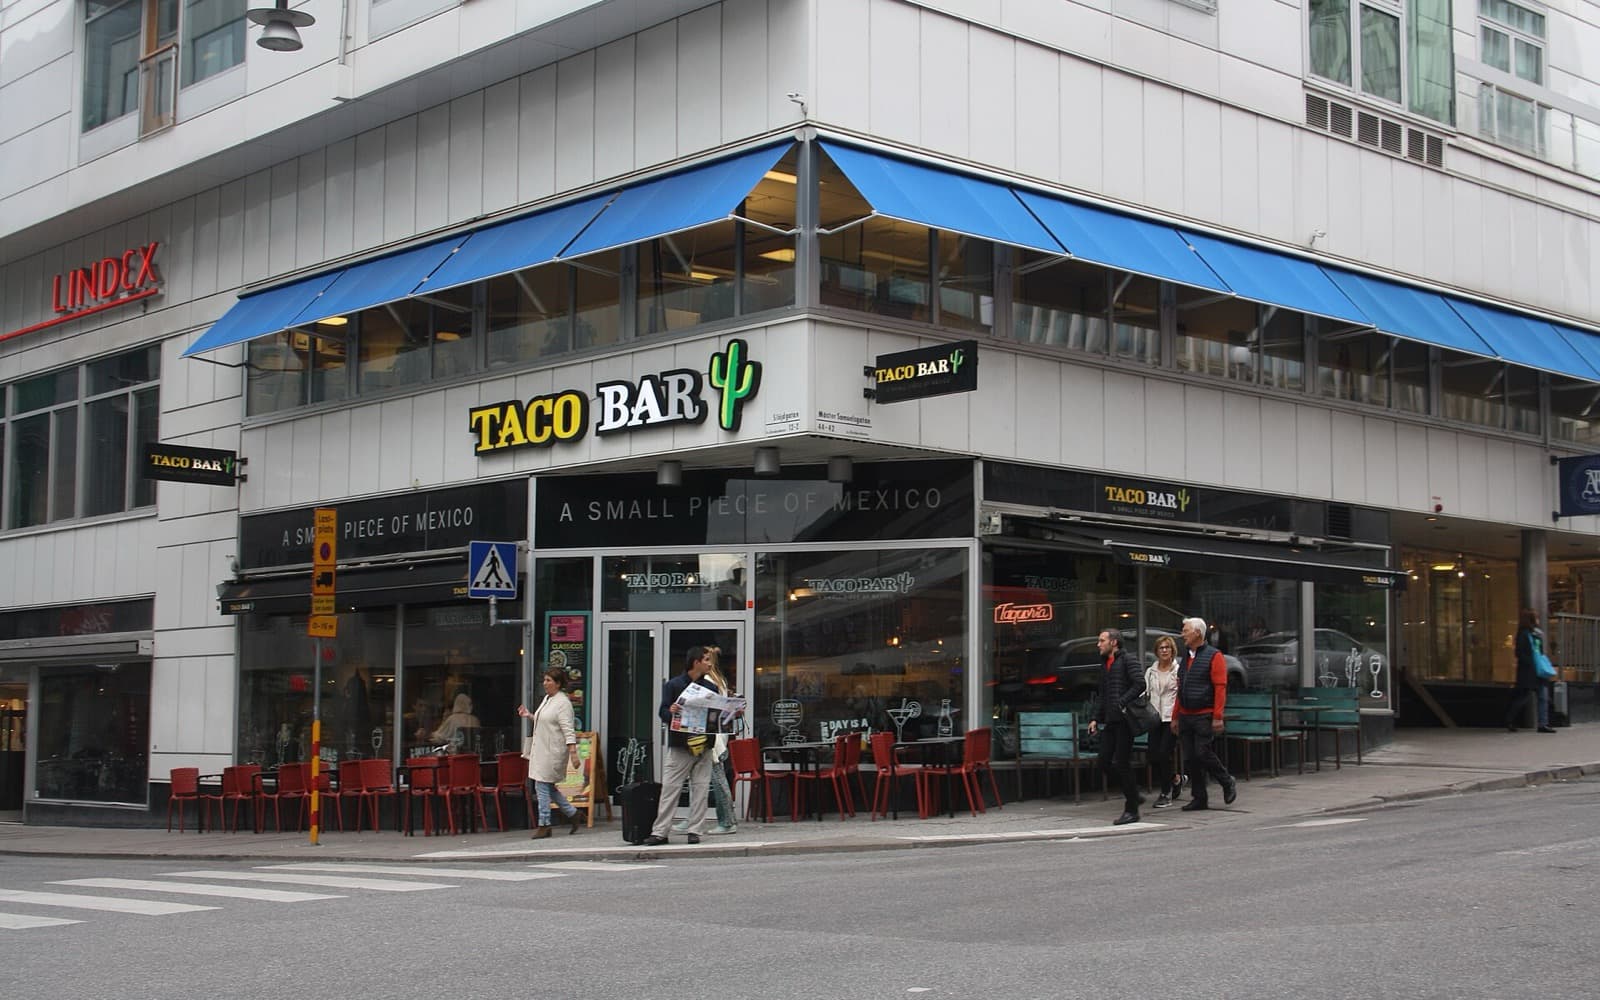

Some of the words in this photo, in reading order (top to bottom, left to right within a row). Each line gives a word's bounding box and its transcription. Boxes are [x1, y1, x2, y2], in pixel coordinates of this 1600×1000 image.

[53, 242, 158, 313] LINDEX
[875, 365, 915, 384] TACO
[917, 359, 950, 377] BAR
[471, 393, 583, 453] TACO
[598, 373, 700, 432] BAR
[151, 454, 190, 469] TACO
[191, 458, 223, 472] BAR
[559, 502, 573, 522] A
[588, 498, 675, 521] SMALL
[689, 495, 767, 516] PIECE
[784, 495, 816, 512] OF
[833, 488, 942, 511] MEXICO
[1105, 486, 1145, 505] TACO
[1146, 490, 1177, 509] BAR
[282, 530, 290, 547] A
[344, 517, 385, 540] PIECE
[391, 514, 409, 534] OF
[416, 506, 474, 532] MEXICO
[1129, 552, 1148, 561] TACO
[1149, 554, 1164, 562] BAR
[626, 573, 672, 588] TACO
[672, 573, 709, 587] BAR
[809, 579, 858, 593] TACO
[858, 578, 898, 592] BAR
[829, 720, 849, 729] DAY
[861, 718, 869, 727] A
